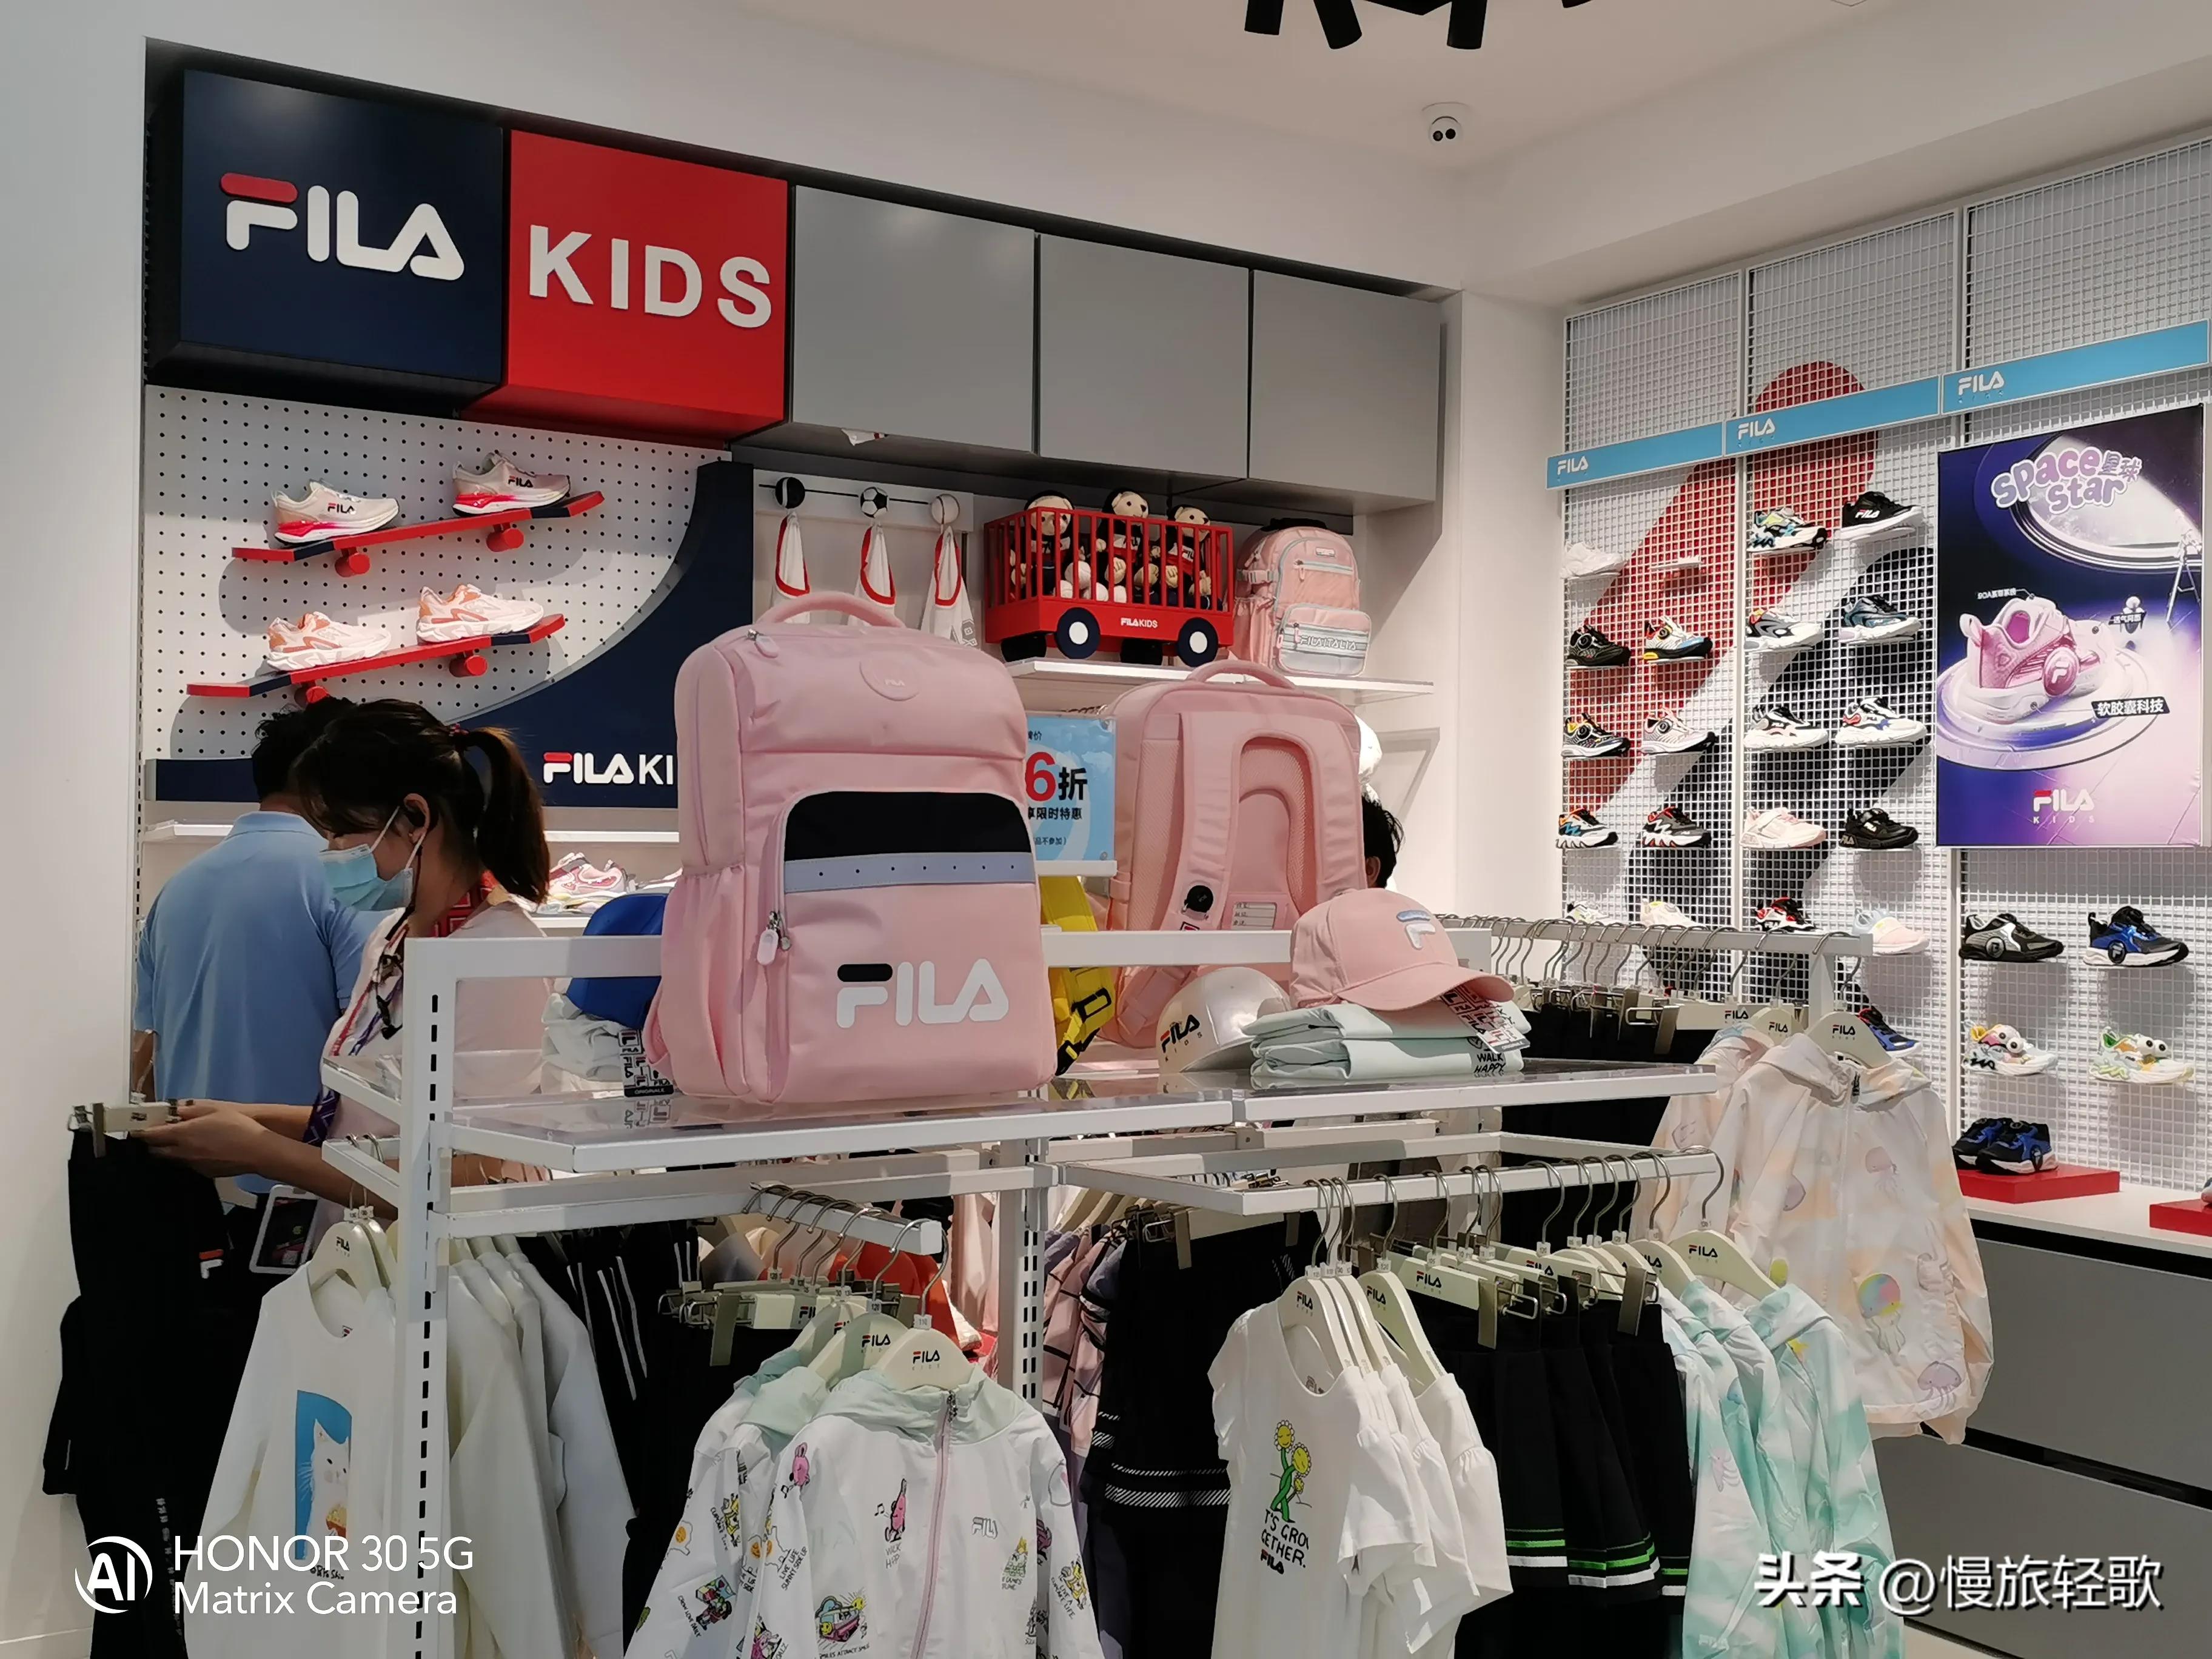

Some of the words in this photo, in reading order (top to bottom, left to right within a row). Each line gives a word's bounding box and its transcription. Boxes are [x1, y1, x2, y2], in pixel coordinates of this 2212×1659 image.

[220, 172, 465, 281] FILA
[528, 224, 772, 329] KIDS
[1959, 370, 2005, 395] FILA
[1737, 418, 1775, 440] FILA
[1557, 455, 1589, 475] FILA
[508, 475, 533, 489] FILA
[327, 503, 355, 514] FILA
[1855, 509, 1880, 519] FILA
[2097, 698, 2164, 717] 软胶囊科技
[543, 752, 634, 784] FILA
[2033, 789, 2094, 813] FILA
[836, 958, 1010, 1029] FILA
[1724, 1007, 1749, 1019] FILA
[1160, 1014, 1201, 1053] FILA
[1769, 1021, 1788, 1033] FILA
[1832, 1024, 1855, 1036] FILA
[1476, 1053, 1504, 1062] WALK
[1689, 1244, 1718, 1258] FILA
[1416, 1270, 1442, 1289] FILA
[1297, 1291, 1313, 1310] FILA
[1366, 1285, 1386, 1305] FILA
[862, 1334, 891, 1348] FILA
[913, 1350, 940, 1364] FILA
[1261, 1549, 1284, 1575] FILA
